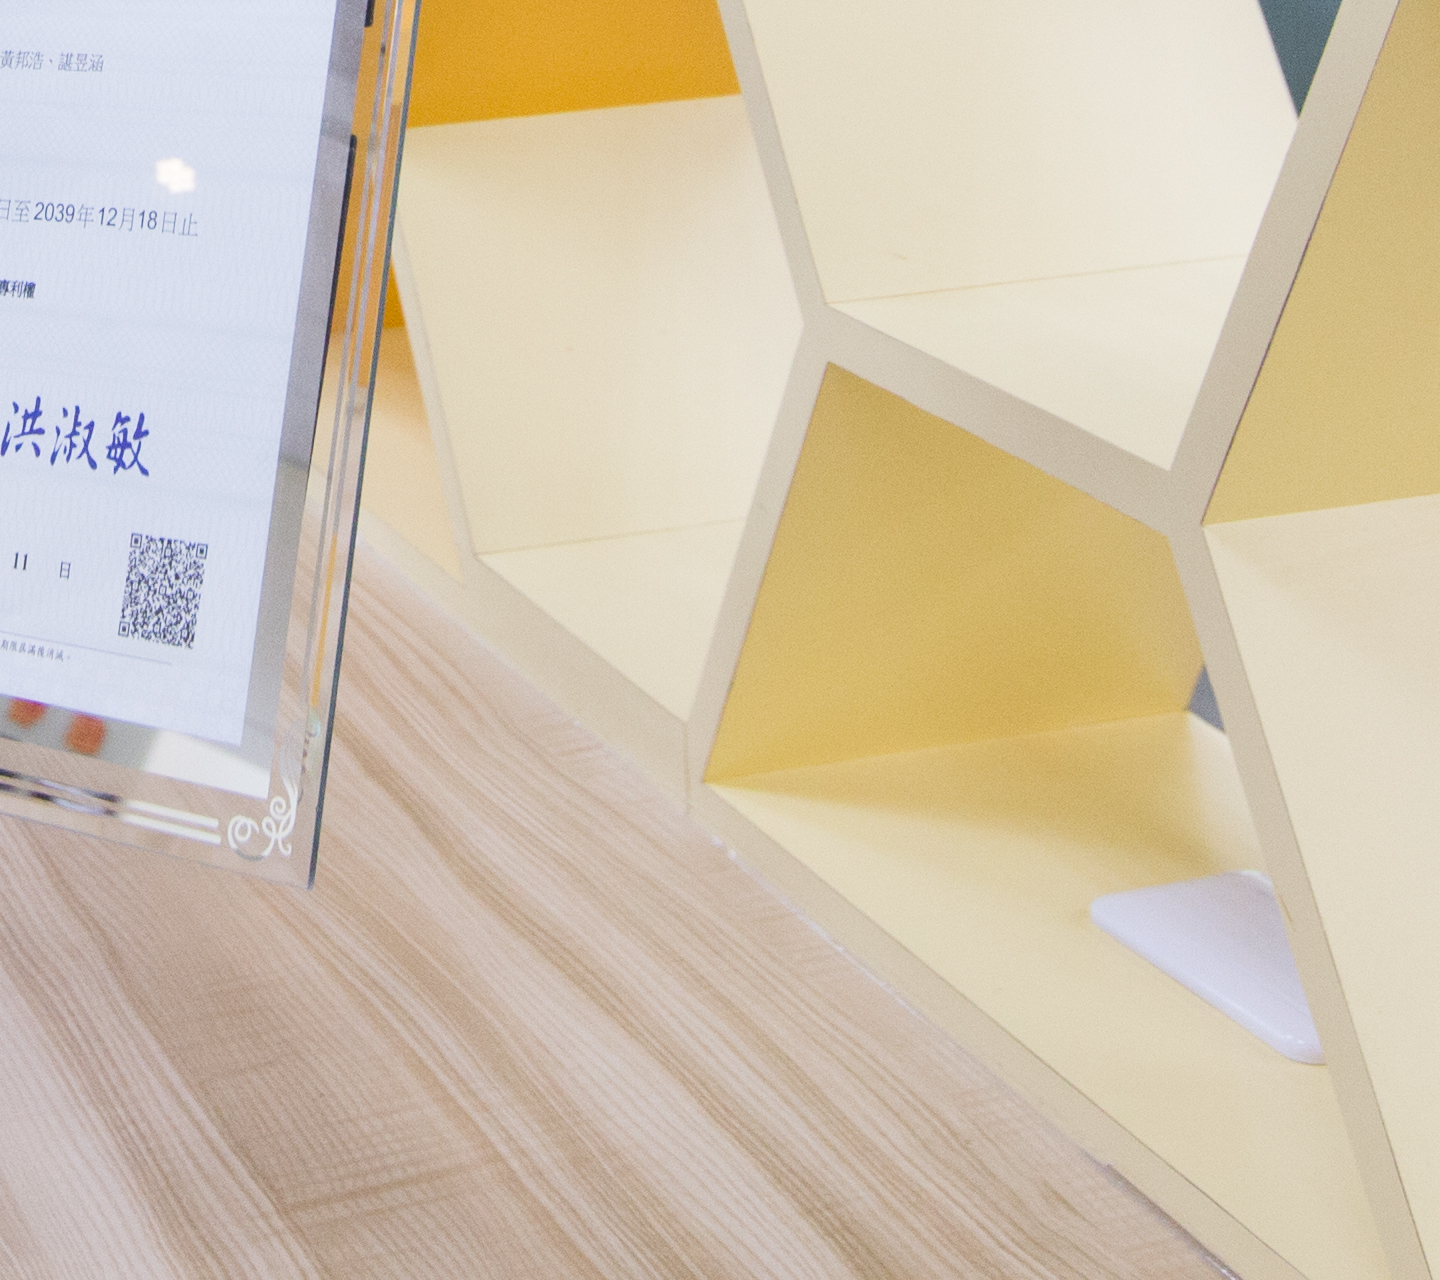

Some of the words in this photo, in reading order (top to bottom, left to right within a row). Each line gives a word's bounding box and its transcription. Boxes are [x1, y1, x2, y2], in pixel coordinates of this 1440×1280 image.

[0, 395, 150, 477] 洪淑敏
[12, 551, 29, 571] 11
[58, 560, 72, 580] 日
